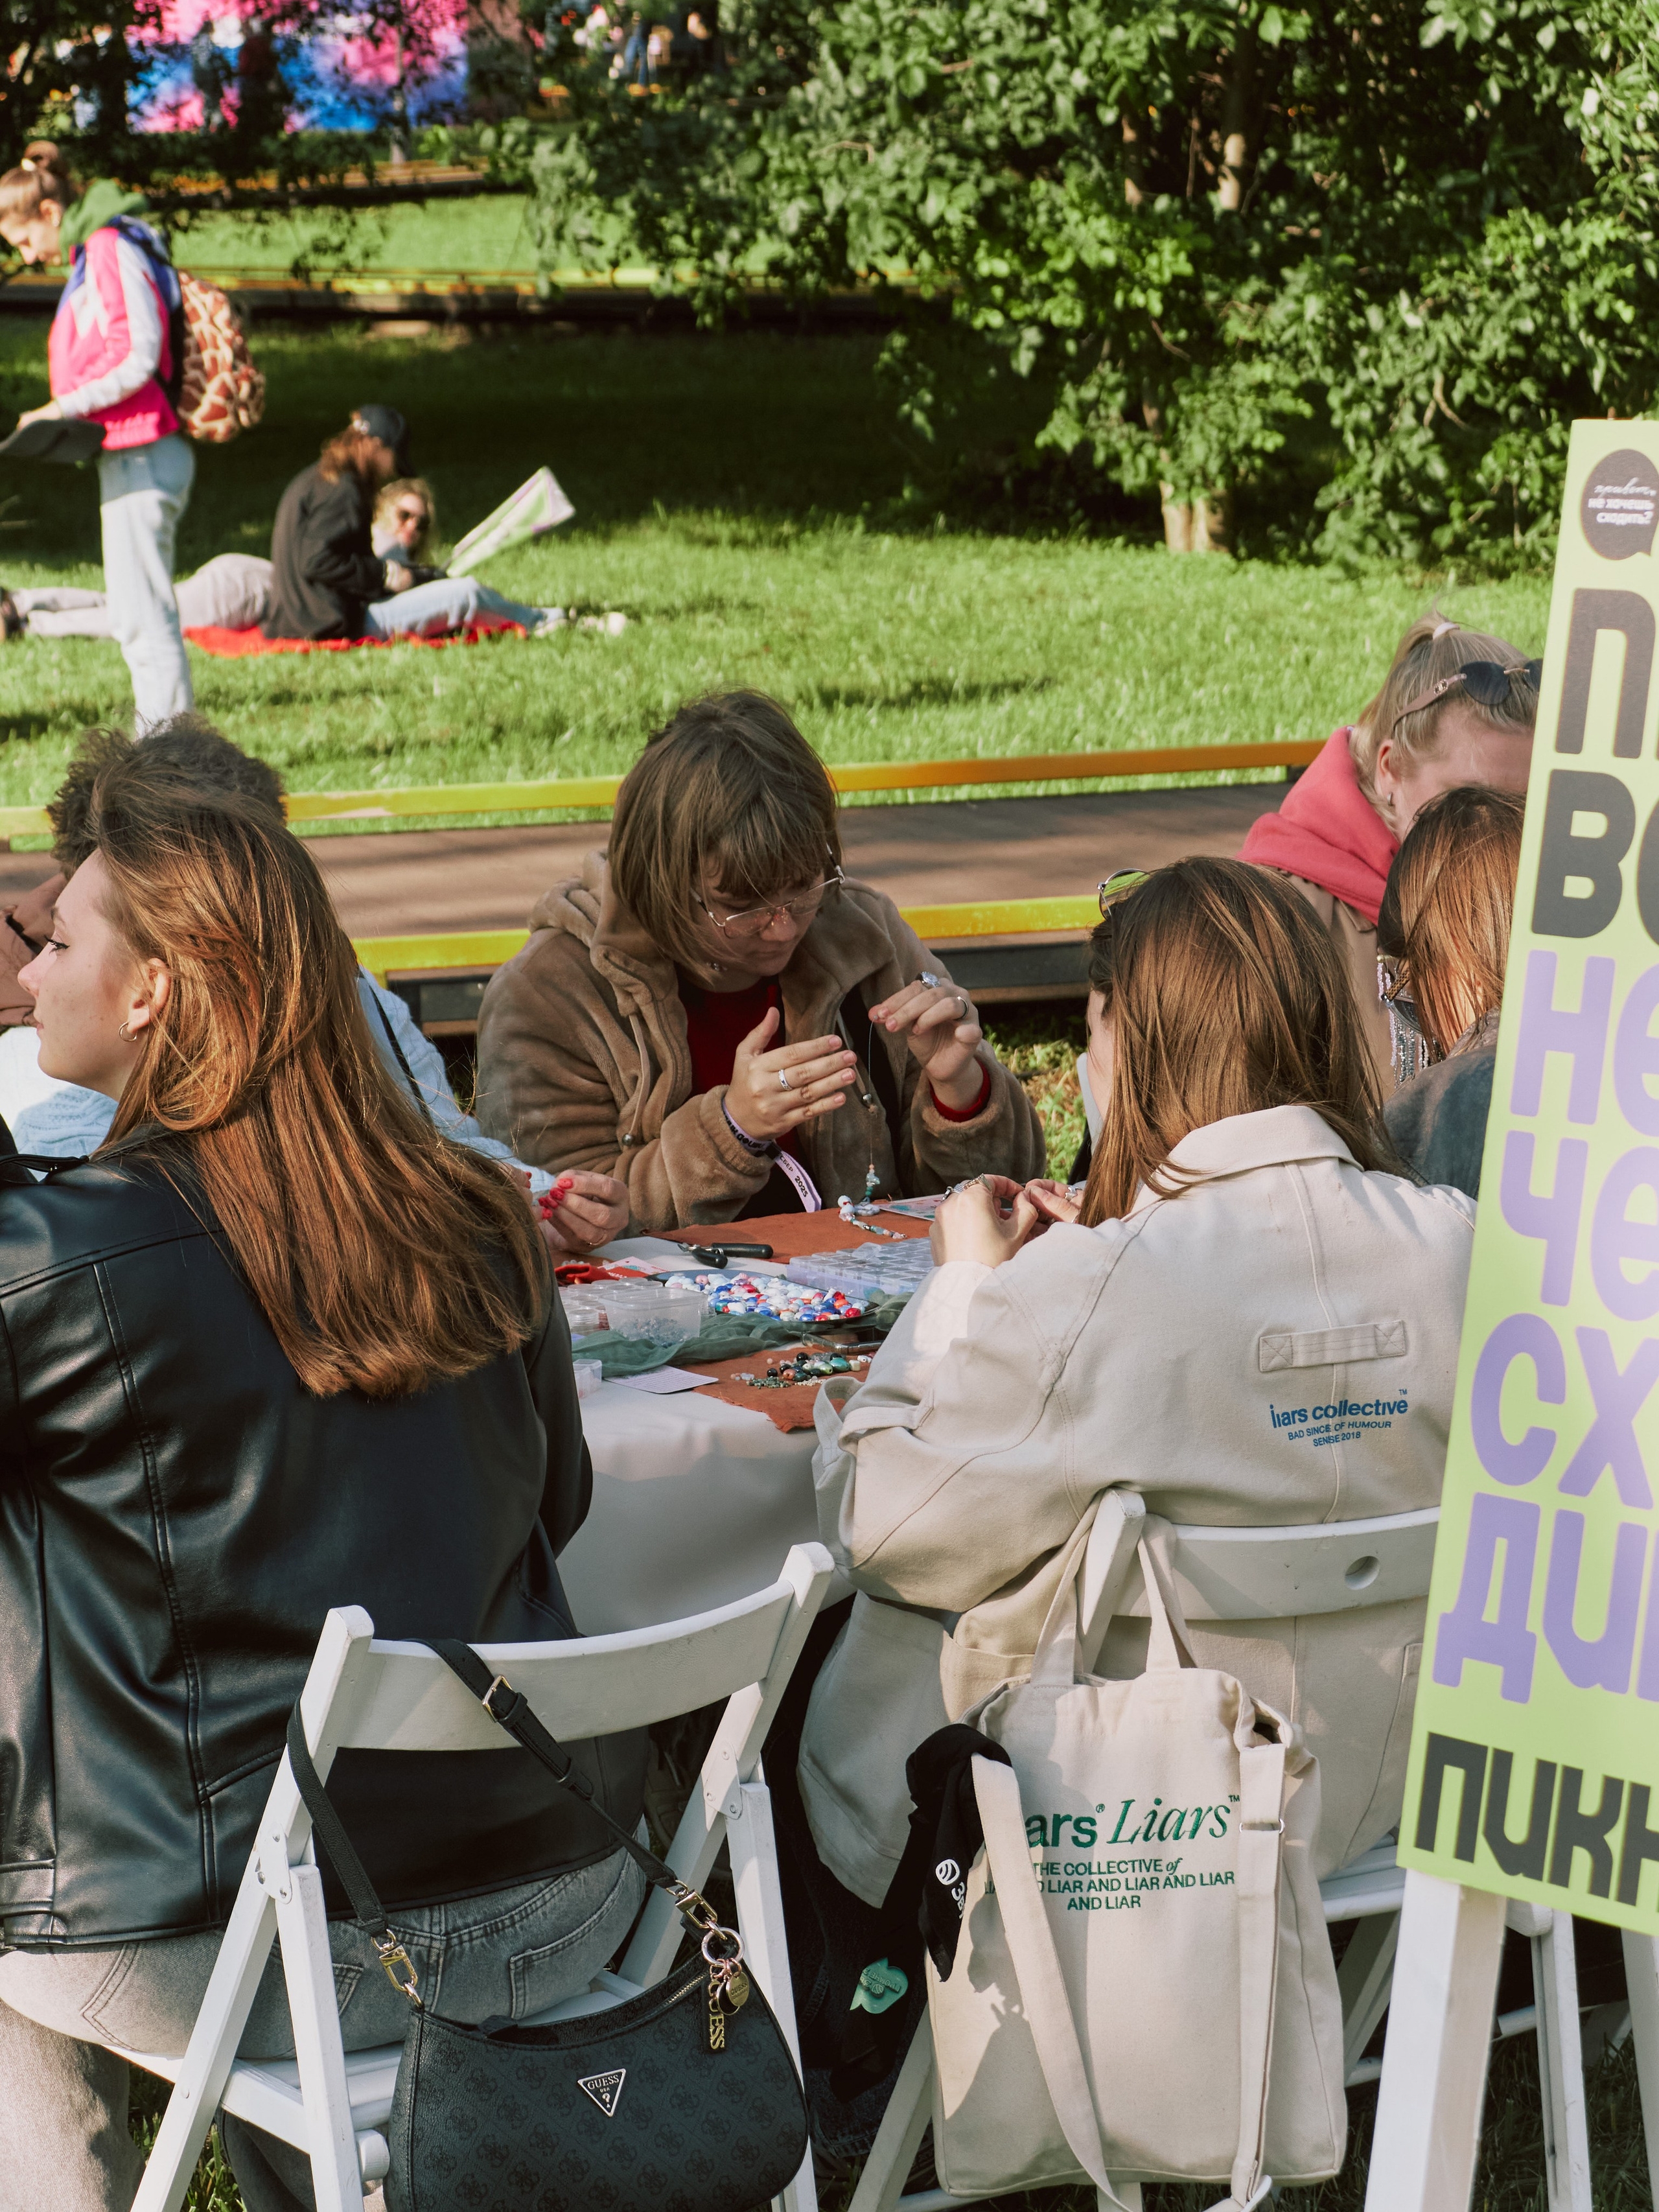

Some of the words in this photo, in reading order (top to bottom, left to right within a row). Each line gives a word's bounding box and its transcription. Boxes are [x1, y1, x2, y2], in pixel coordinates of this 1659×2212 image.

[1555, 588, 1659, 760] П
[780, 1155, 793, 1172] СБЕР
[795, 1176, 808, 1197] 2025
[1288, 1429, 1305, 1440] BAD
[1306, 1424, 1331, 1436] SINCE
[1334, 1422, 1345, 1431] OF
[1313, 1435, 1340, 1447] SENSE
[1341, 1431, 1361, 1441] 2018
[1034, 1862, 1061, 1876] THE
[1064, 1859, 1163, 1876] COLLECTIVE
[1166, 1857, 1183, 1874] of
[1048, 1880, 1083, 1893] LIAR
[1087, 1879, 1121, 1892] AND
[1125, 1877, 1159, 1891] LIAR
[1163, 1874, 1196, 1889] AND
[1200, 1871, 1235, 1886] LIAR
[1067, 1896, 1102, 1911] AND
[1105, 1896, 1141, 1909] LIAR
[731, 1983, 747, 1995] GUESS
[587, 2075, 619, 2090] GUESS
